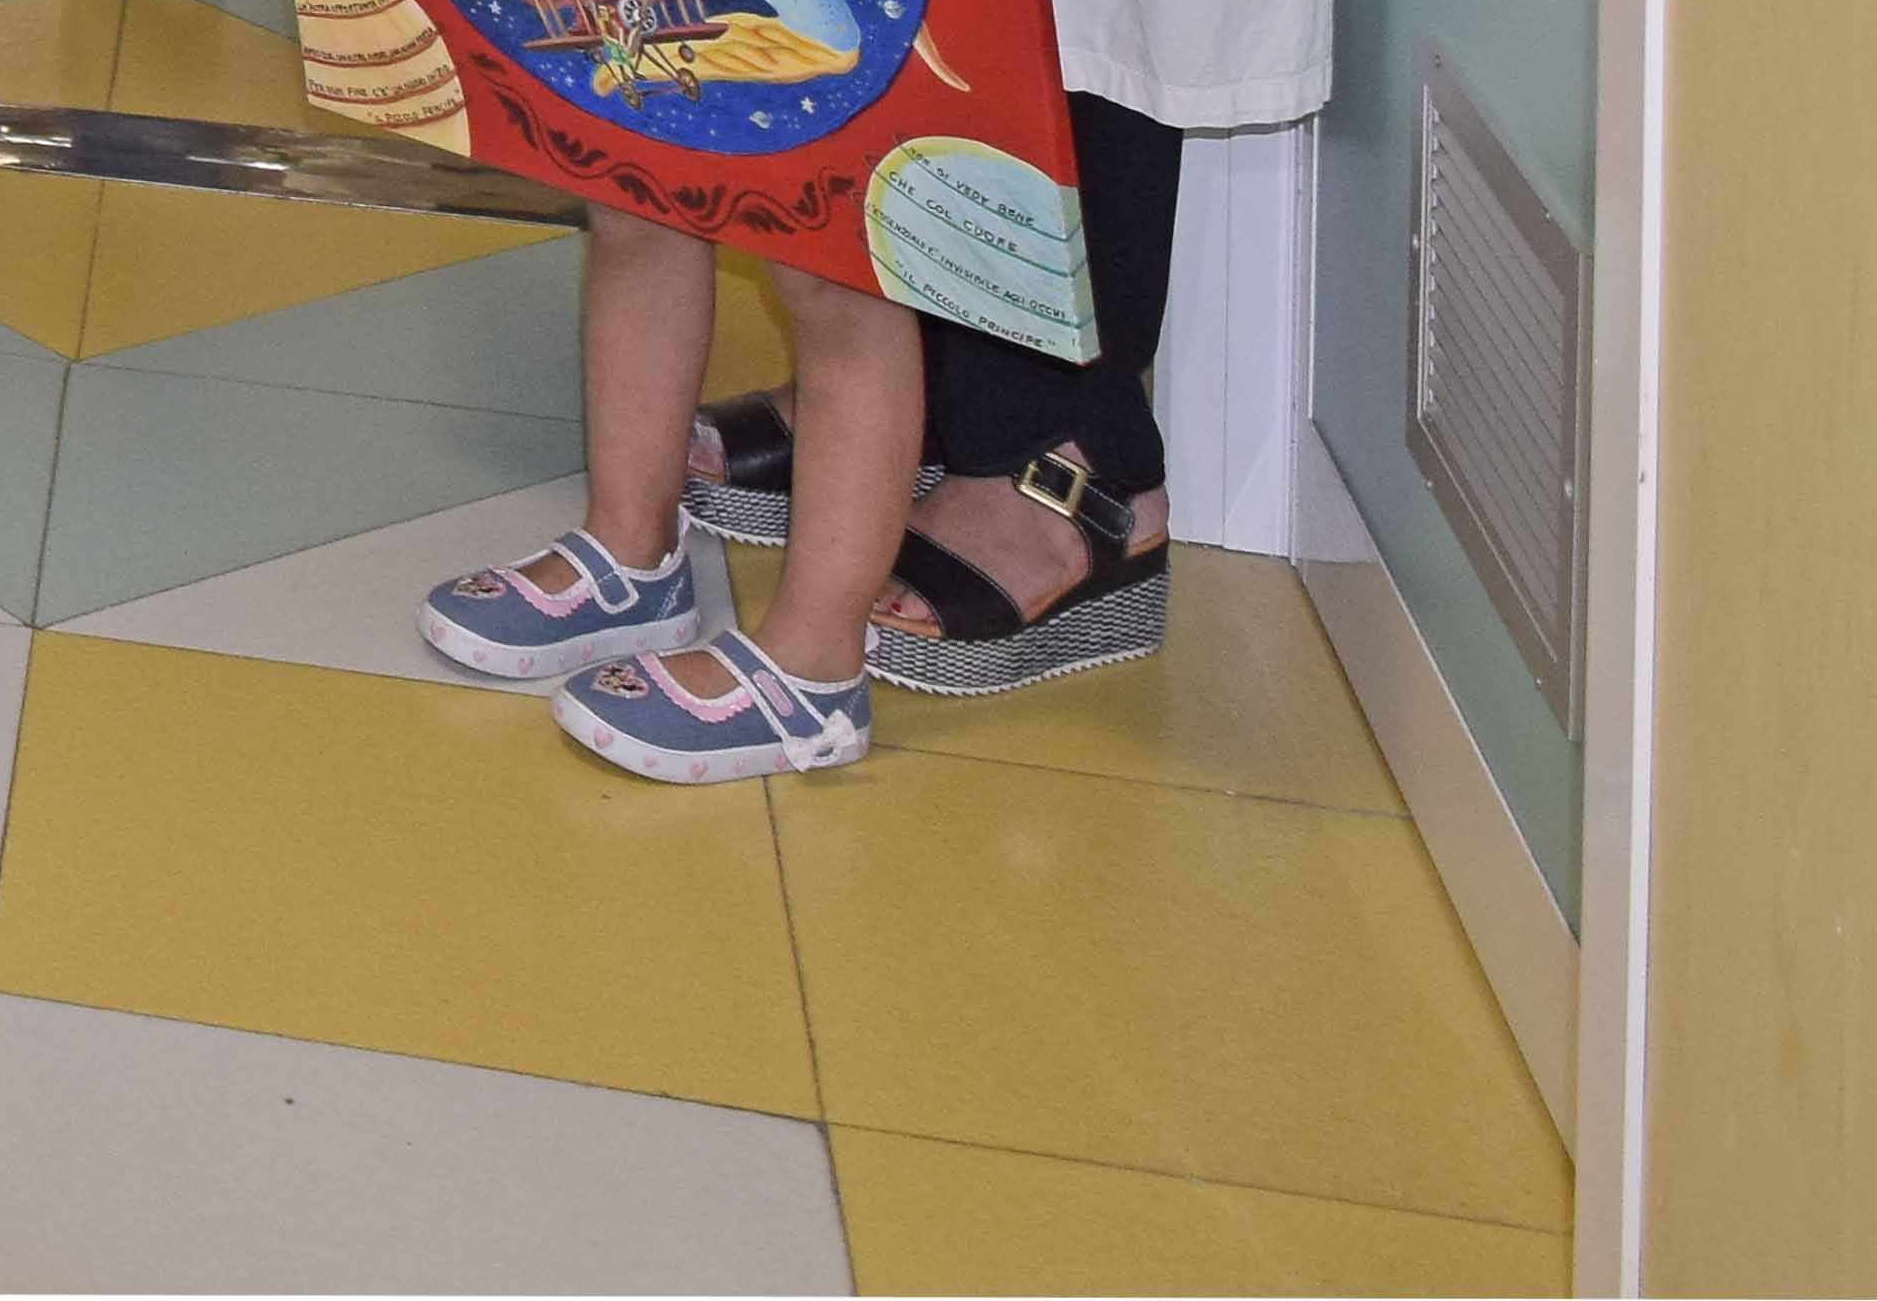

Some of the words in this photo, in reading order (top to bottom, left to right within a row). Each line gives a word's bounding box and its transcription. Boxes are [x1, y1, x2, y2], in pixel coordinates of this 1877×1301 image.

[887, 171, 916, 197] CHE
[925, 198, 953, 221] COL
[955, 180, 990, 206] VEDE
[996, 202, 1035, 228] BENE
[922, 283, 970, 320] PICCOLO
